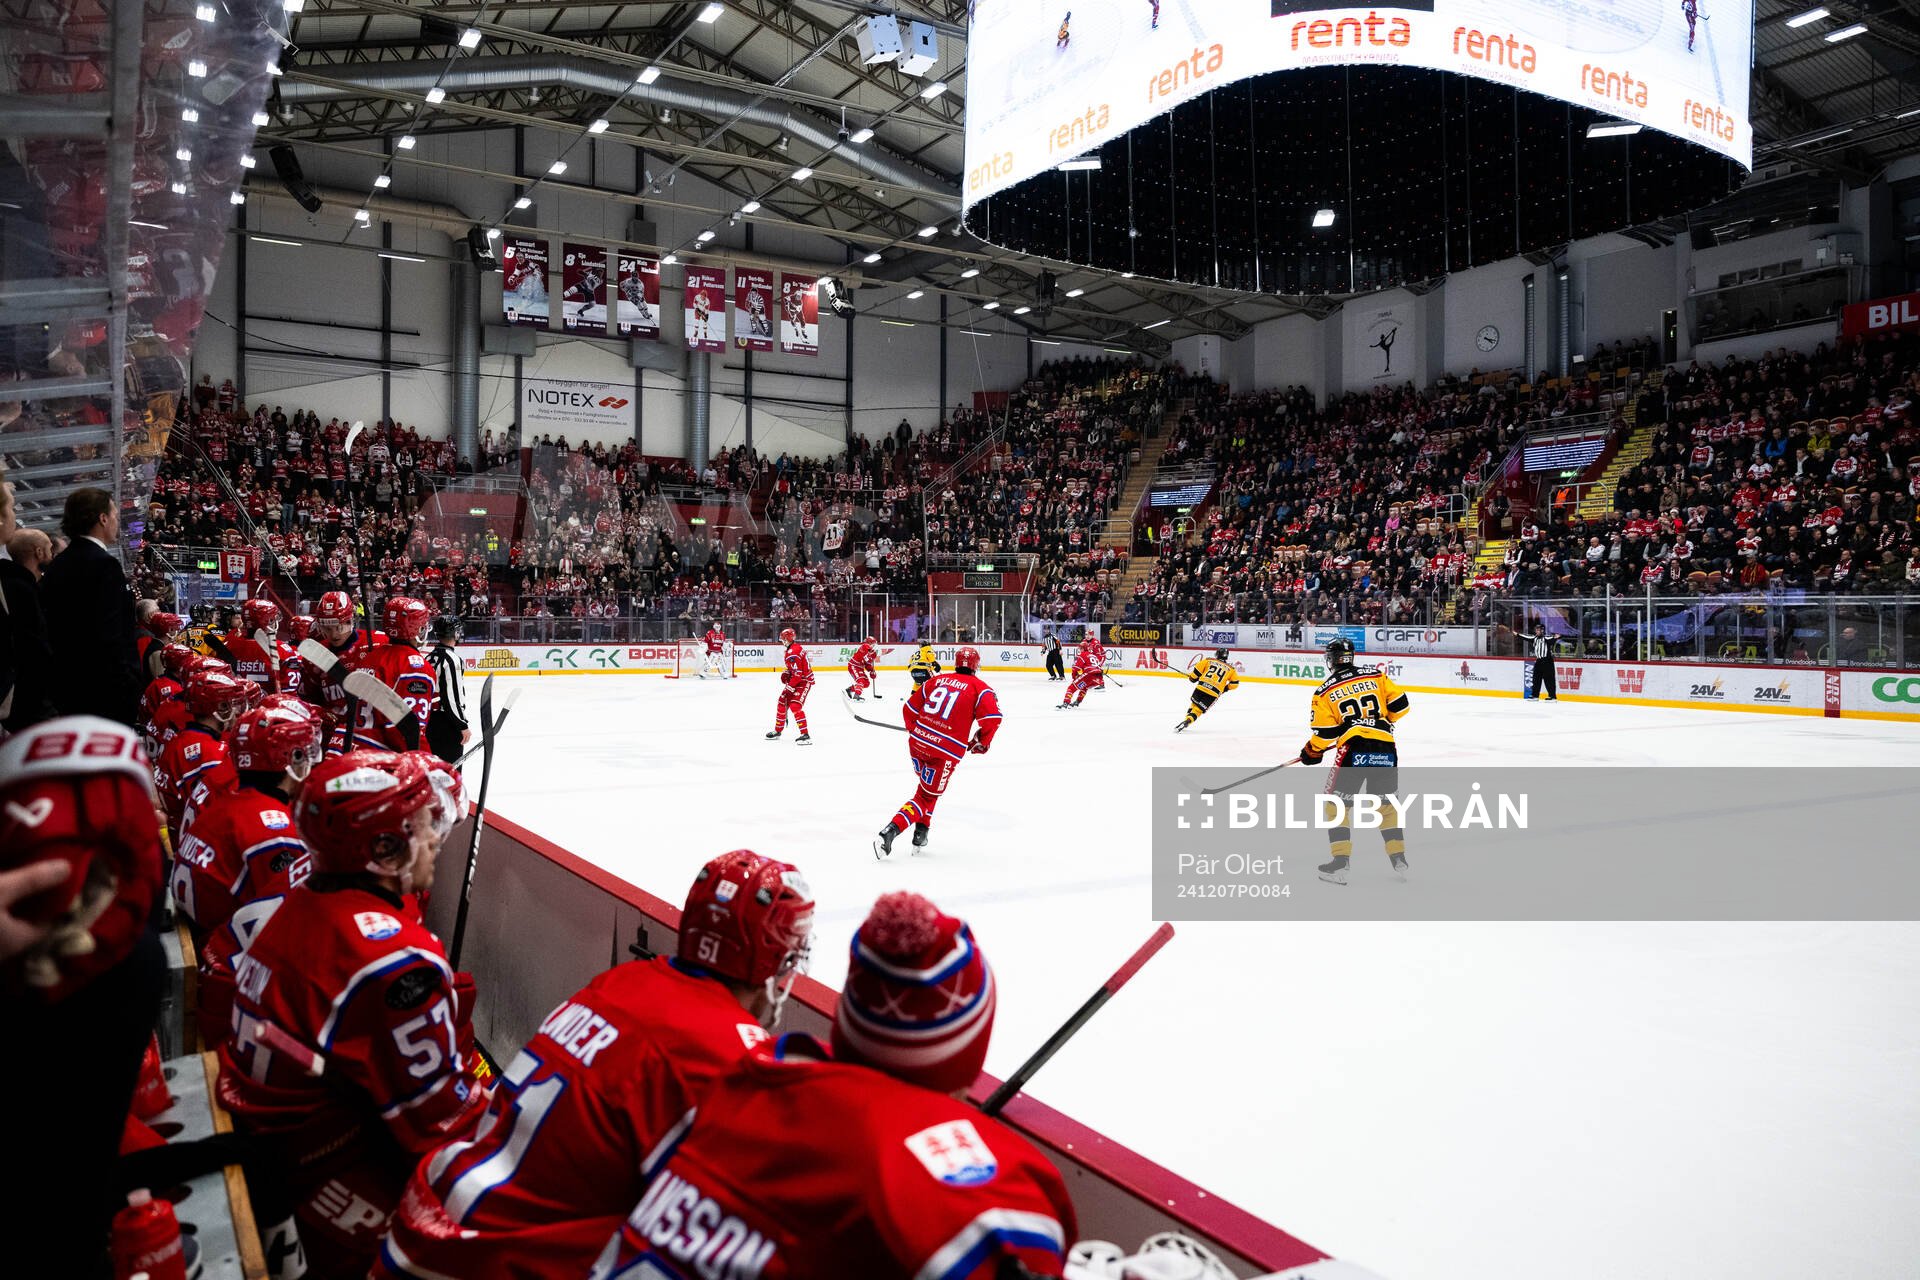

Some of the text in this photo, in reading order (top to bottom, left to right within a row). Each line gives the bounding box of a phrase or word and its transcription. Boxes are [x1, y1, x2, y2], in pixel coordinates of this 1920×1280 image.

[1290, 10, 1411, 51] renta
[1453, 26, 1536, 74] renta
[1148, 42, 1224, 104] renta
[1582, 63, 1648, 109] renta
[1048, 103, 1111, 155] renta
[1683, 98, 1735, 142] renta
[967, 151, 1014, 195] renta
[504, 246, 517, 259] 5
[564, 254, 576, 267] 8
[619, 259, 636, 272] 24
[687, 276, 701, 288] 21
[737, 276, 747, 288] 11
[783, 282, 791, 294] 8
[1868, 300, 1919, 329] BIL
[528, 388, 595, 409] NOTEX
[1191, 629, 1214, 642] L&S
[1257, 631, 1274, 639] MM
[484, 649, 510, 659] EURO
[545, 648, 578, 668] GK
[589, 648, 621, 668] GK
[628, 648, 696, 660] BORGA
[1135, 650, 1169, 670] ABB
[1205, 665, 1226, 682] 24
[1272, 663, 1326, 678] TIRAB
[1329, 680, 1379, 702] SELLGREN
[1826, 673, 1840, 705] NRS
[923, 685, 961, 720] 91
[1339, 693, 1381, 722] 23
[238, 754, 251, 768] 29
[697, 936, 720, 965] 51
[391, 997, 457, 1079] 57
